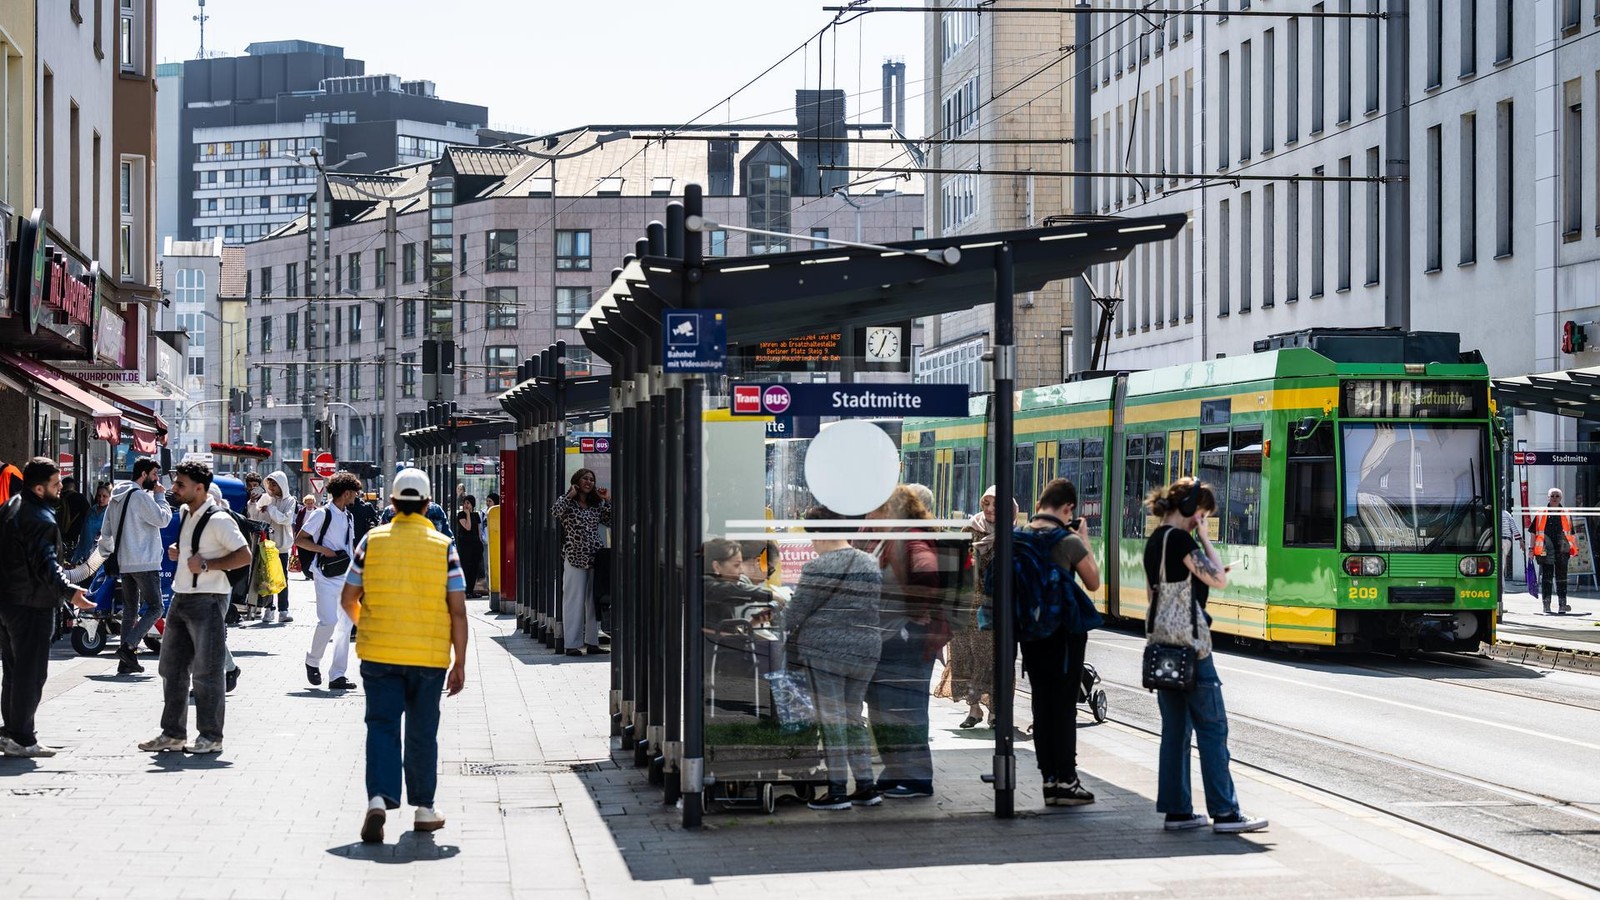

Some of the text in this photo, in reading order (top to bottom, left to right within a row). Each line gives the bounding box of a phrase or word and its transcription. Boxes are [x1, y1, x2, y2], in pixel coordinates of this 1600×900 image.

[667, 350, 696, 358] Bahnhof
[807, 348, 823, 356] Steig
[755, 354, 781, 362] Richtung
[667, 360, 723, 369] mit Videoanlage
[52, 371, 139, 381] WWRUHRPOINT.DE
[735, 394, 788, 405] Tram BUS
[832, 391, 921, 408] Stadtmitte
[1552, 454, 1588, 463] Stadtmitte
[1348, 587, 1490, 599] 209 STOAG
